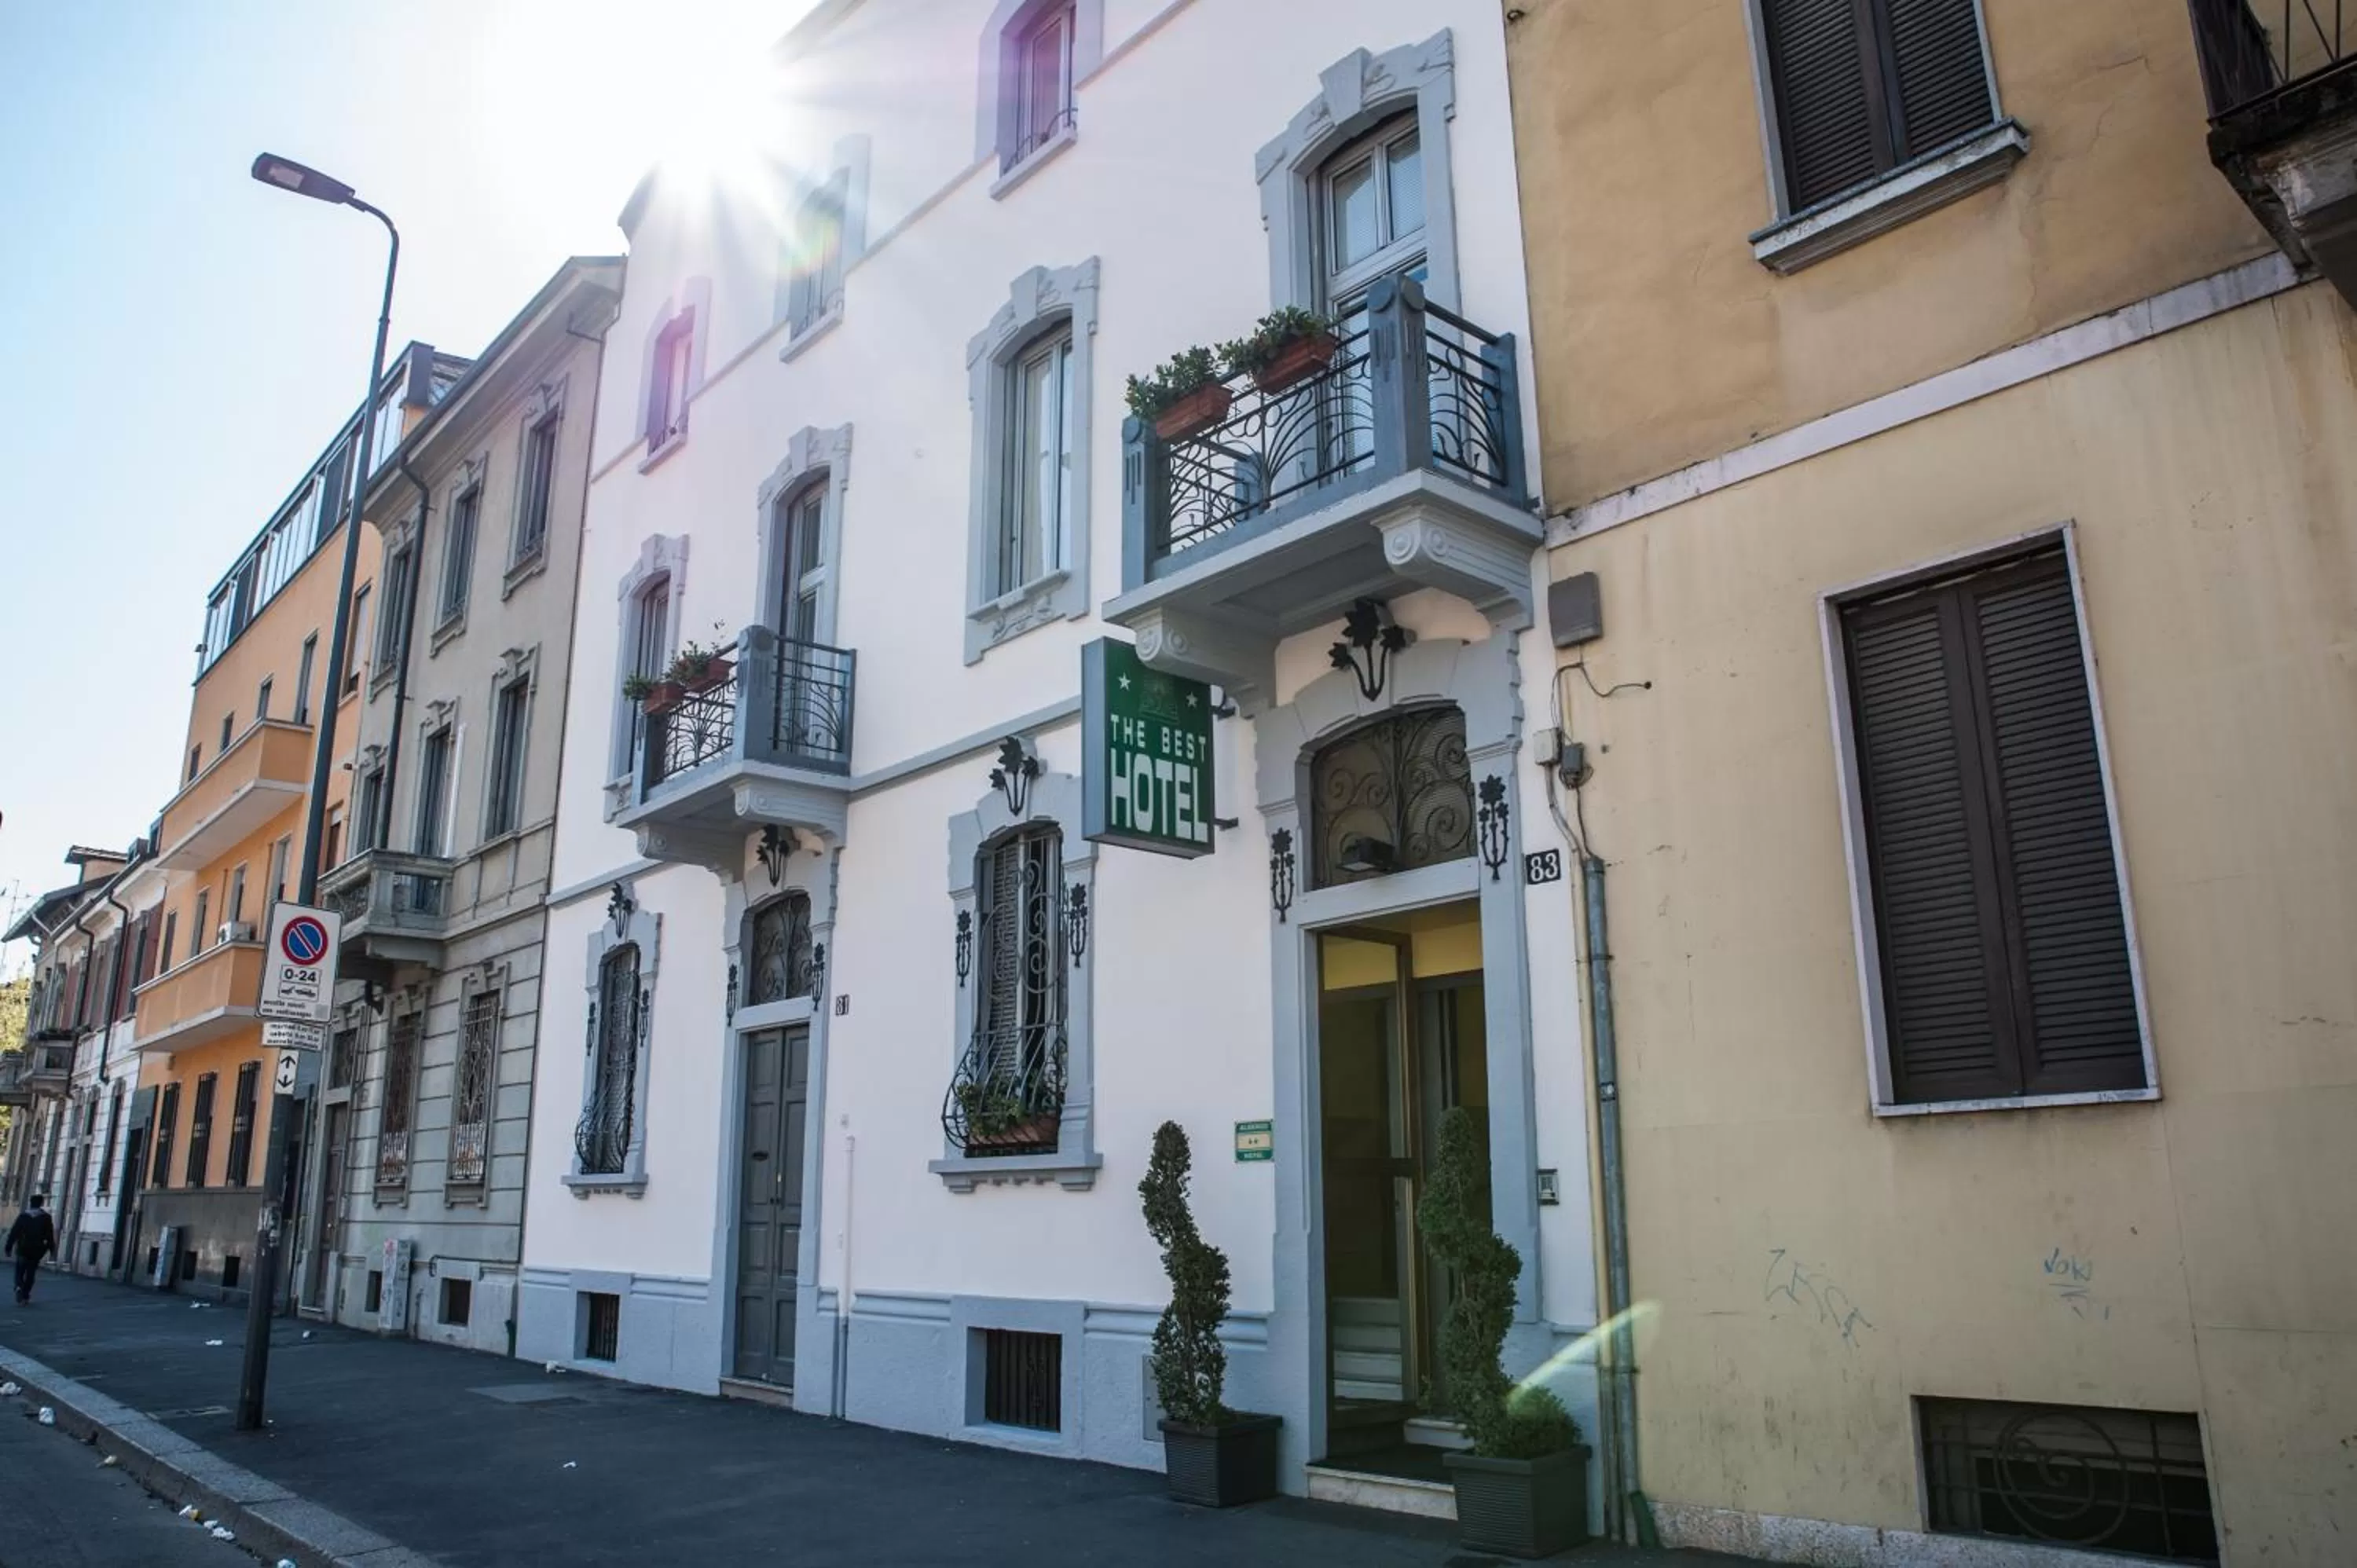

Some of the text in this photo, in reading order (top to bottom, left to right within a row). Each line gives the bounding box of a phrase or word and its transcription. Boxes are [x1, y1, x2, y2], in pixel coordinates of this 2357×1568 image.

[1110, 713, 1207, 763] THE BEST
[1110, 747, 1208, 843] HOTEL
[1530, 852, 1558, 881] 83
[284, 968, 317, 982] 0-24
